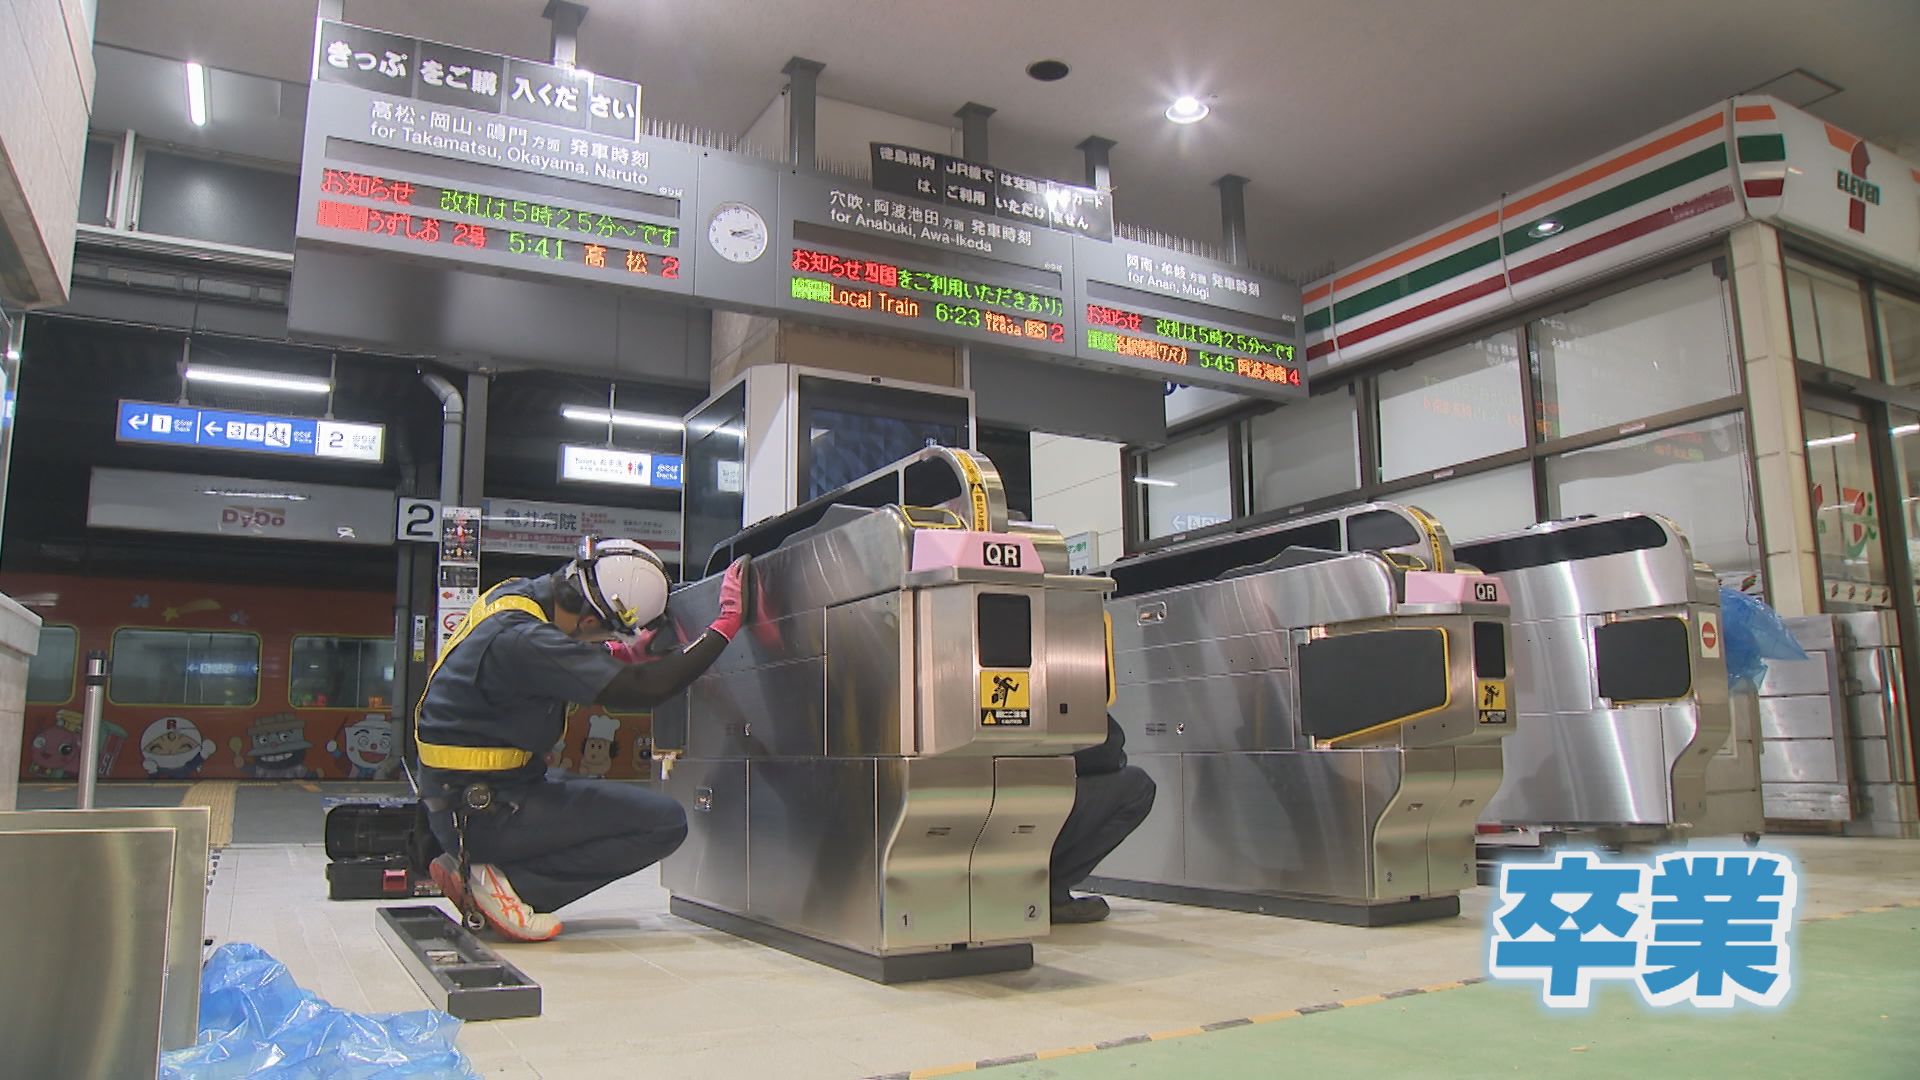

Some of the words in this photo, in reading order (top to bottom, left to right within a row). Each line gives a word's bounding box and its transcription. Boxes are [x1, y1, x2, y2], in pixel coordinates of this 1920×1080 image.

[370, 121, 396, 138] for
[402, 127, 502, 161] Takamatsu,
[507, 146, 589, 176] Okayama,
[595, 162, 648, 185] Naruto
[320, 169, 416, 205] お知らせ
[830, 209, 851, 226] for
[855, 213, 917, 239] Anabuki,
[920, 230, 992, 253] Awa-Ikeda
[508, 231, 565, 261] 5:41
[661, 256, 680, 279] 2
[792, 248, 863, 281] お知らせ
[1128, 270, 1144, 283] for
[1182, 283, 1210, 301] Mugi
[830, 284, 872, 309] Local
[878, 291, 919, 317] Train
[935, 303, 981, 328] 6:23
[1050, 323, 1065, 343] 2
[1199, 351, 1235, 373] 5:45
[1289, 369, 1300, 386] 4
[230, 424, 242, 436] 3
[249, 426, 261, 438] 4
[329, 431, 344, 448] 2
[406, 503, 435, 536] 2
[986, 543, 1020, 567] QR
[1476, 584, 1496, 601] QR
[902, 914, 908, 926] 1
[1028, 905, 1036, 918] 2
